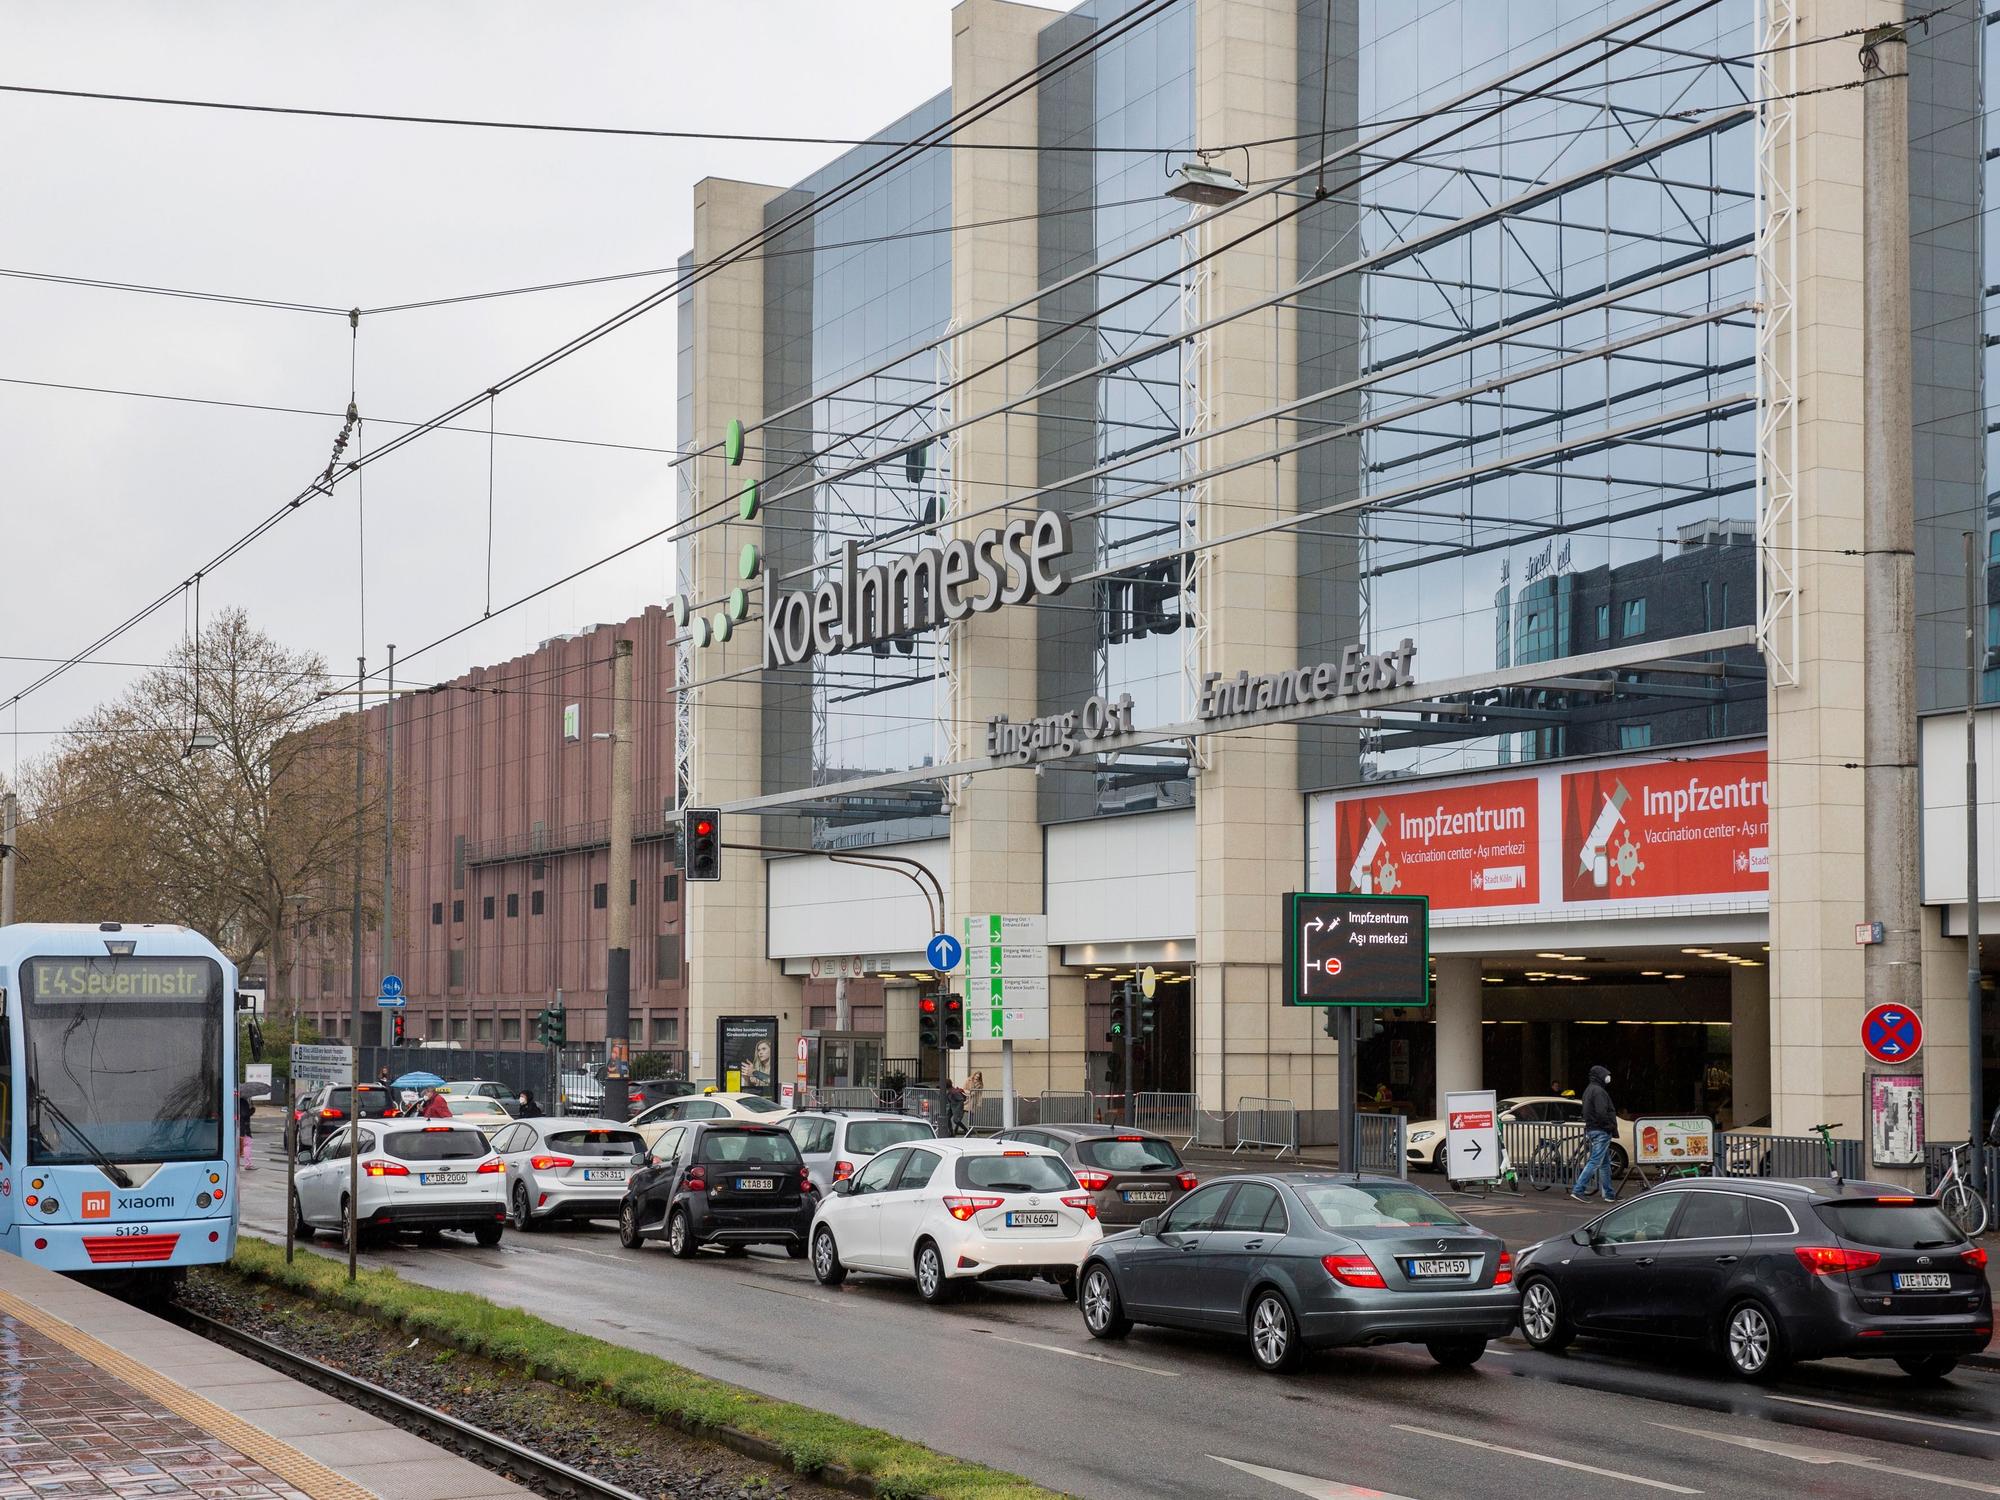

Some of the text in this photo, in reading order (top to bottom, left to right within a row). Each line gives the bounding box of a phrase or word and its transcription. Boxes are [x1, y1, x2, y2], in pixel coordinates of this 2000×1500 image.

[763, 510, 1072, 670] koelnmesse
[1201, 638, 1417, 719] Entrance East
[985, 693, 1135, 764] Eingang Ost
[1400, 805, 1526, 845] Impfzentrum
[1644, 825, 1702, 844] Vaccination
[1703, 823, 1736, 840] center
[1741, 820, 1758, 838] Aşı
[1401, 849, 1447, 864] Vaccination
[1447, 848, 1473, 861] center
[1491, 841, 1526, 857] merkezi
[1484, 872, 1499, 885] Stadt
[1348, 911, 1409, 925] Impfzentrum
[1348, 931, 1408, 947] Aşı merkezi
[71, 966, 204, 995] Severinstr.
[118, 1196, 175, 1210] xiaomi
[1033, 1214, 1054, 1223] 6694
[115, 1225, 149, 1237] 5129
[1452, 1261, 1465, 1272] 59
[1933, 1275, 1949, 1286] 372
